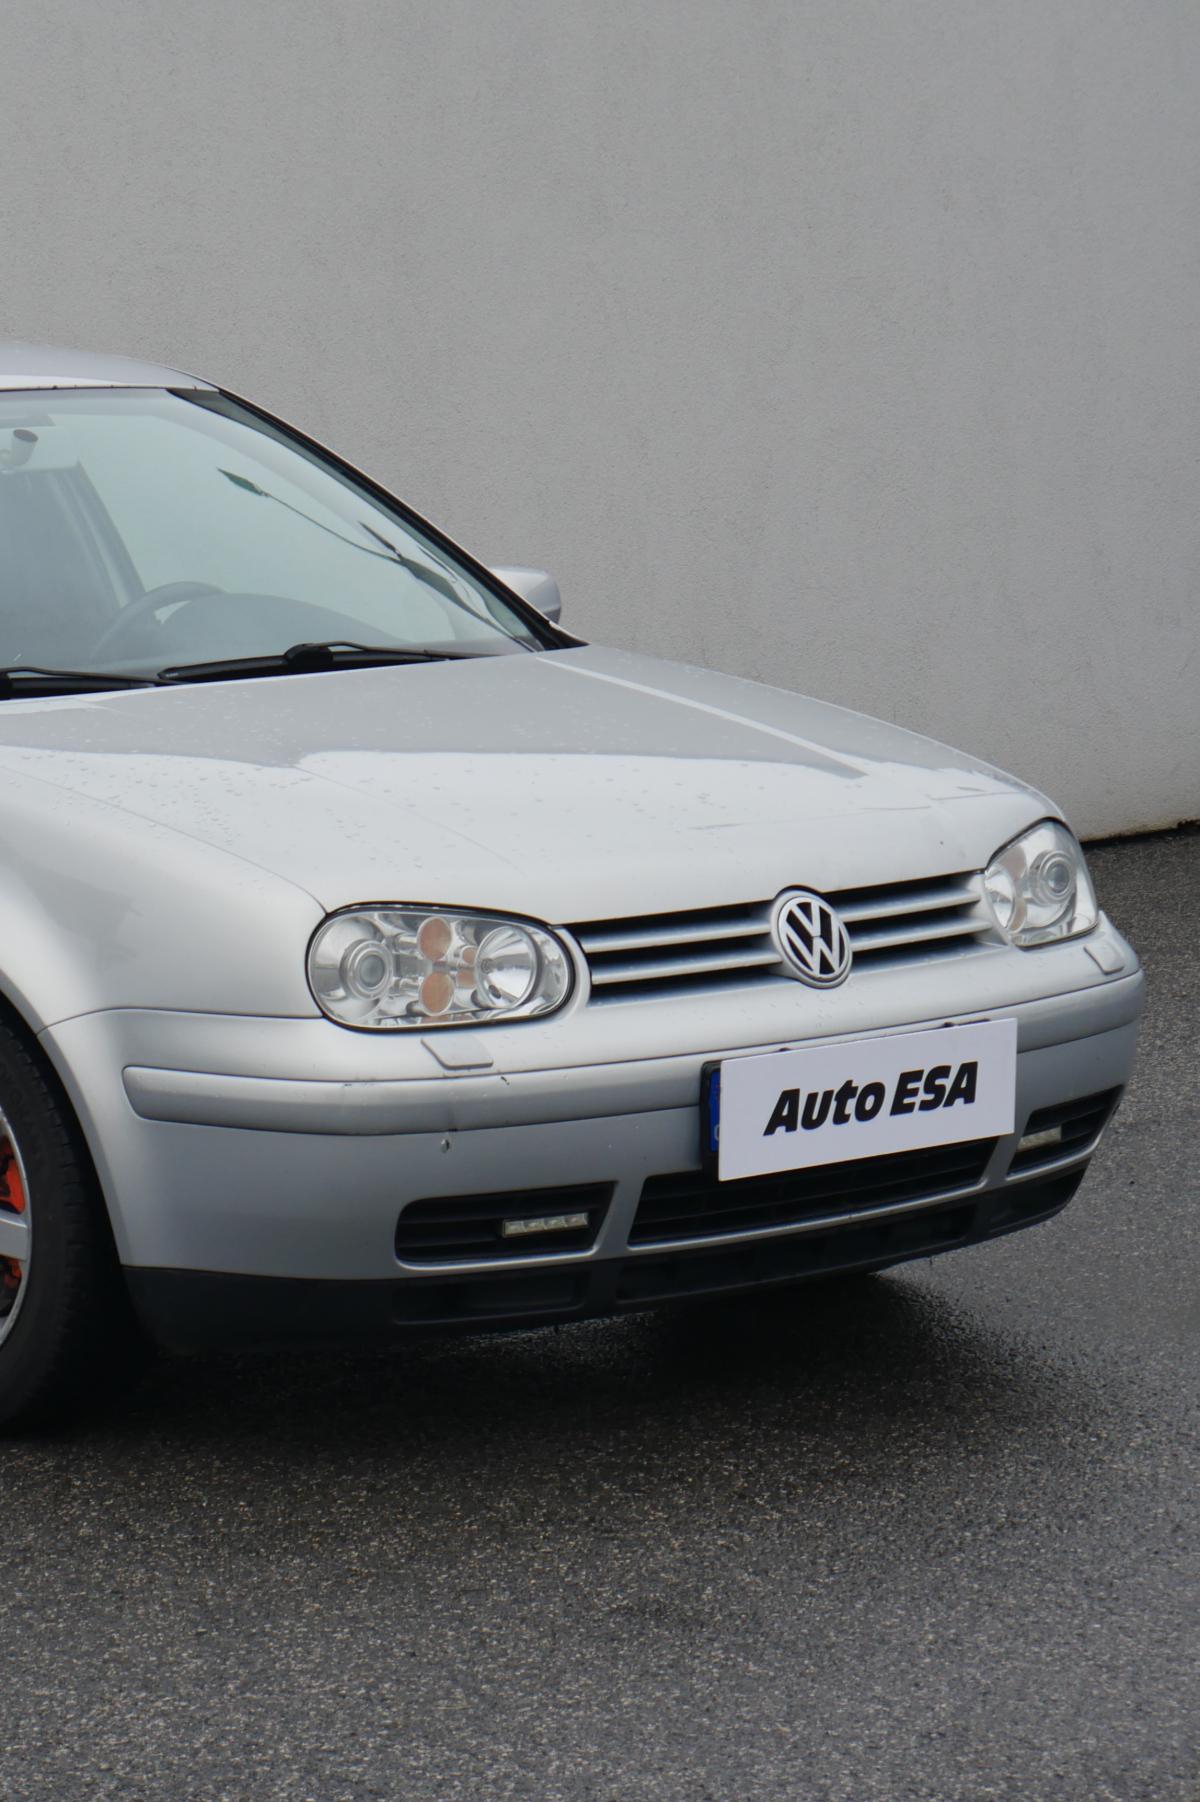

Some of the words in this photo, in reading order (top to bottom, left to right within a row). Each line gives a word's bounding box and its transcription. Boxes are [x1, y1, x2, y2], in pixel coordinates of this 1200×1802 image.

[778, 894, 850, 982] VW
[762, 1079, 886, 1137] Auto
[889, 1060, 979, 1117] ESA
